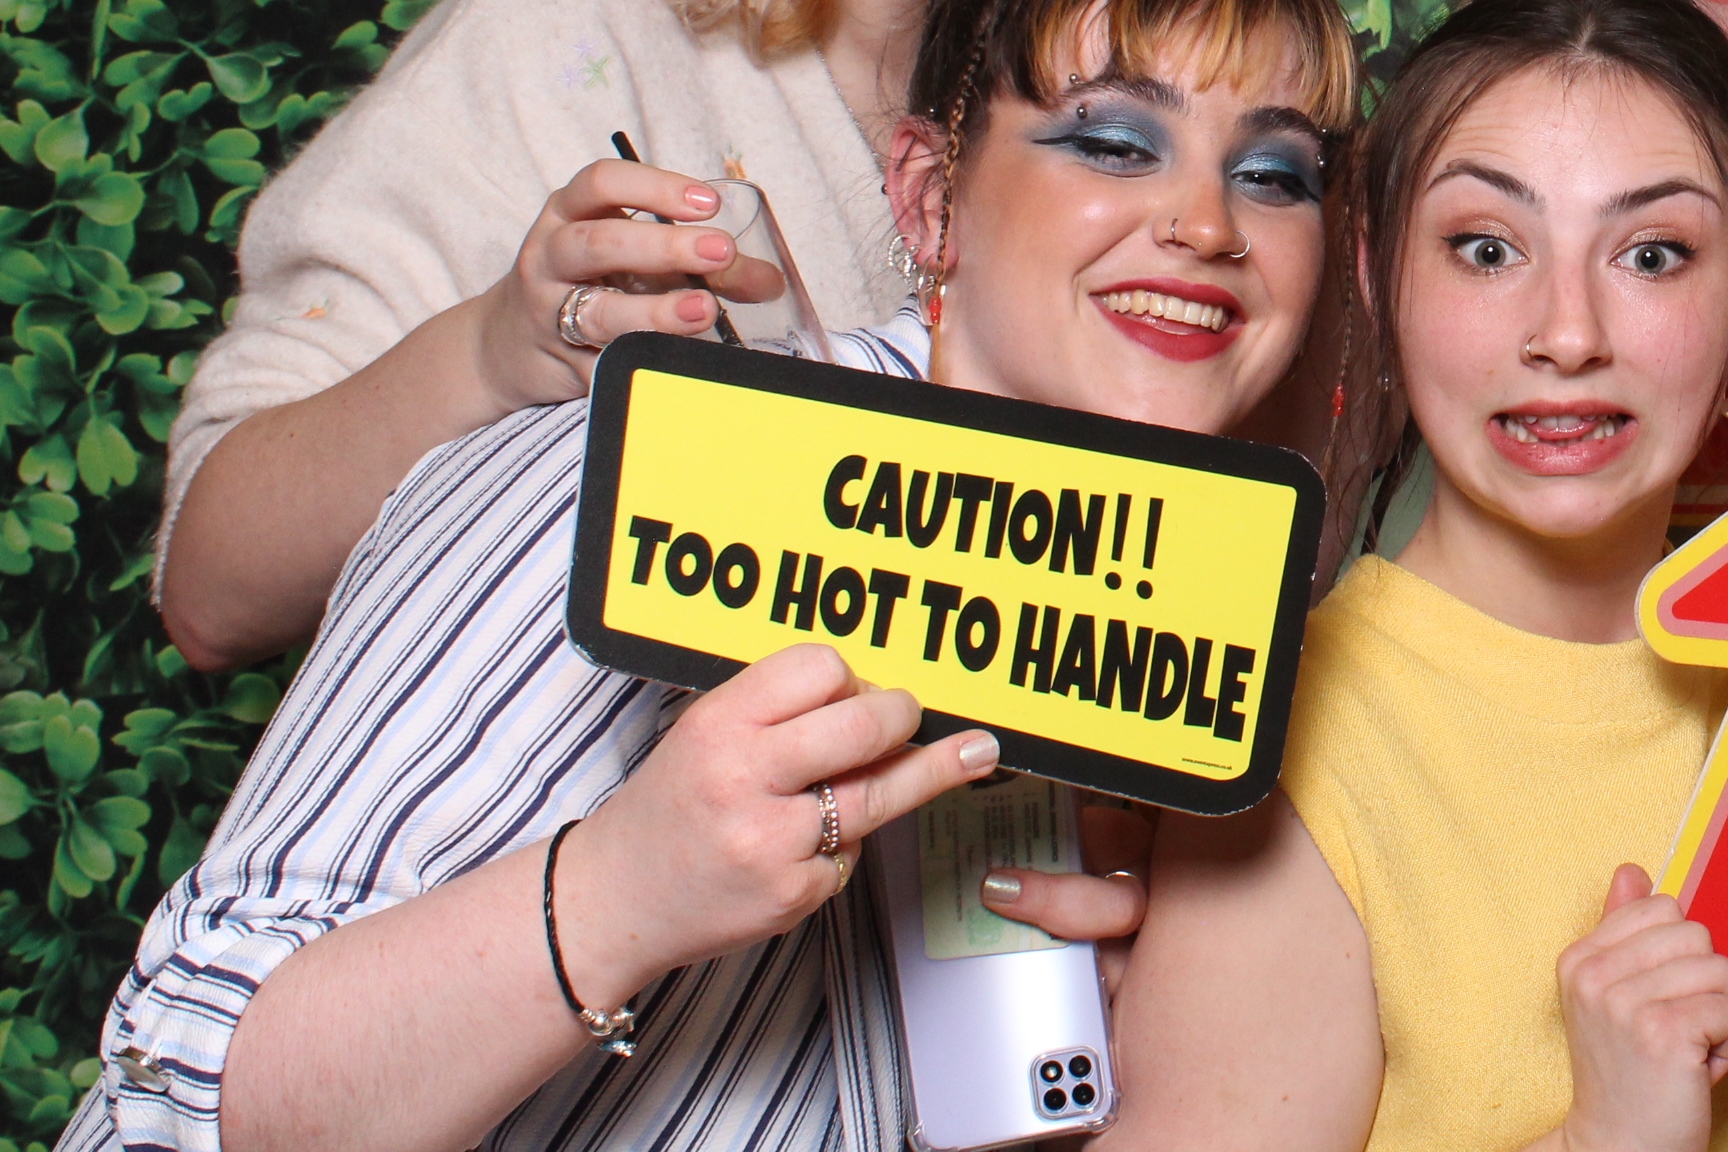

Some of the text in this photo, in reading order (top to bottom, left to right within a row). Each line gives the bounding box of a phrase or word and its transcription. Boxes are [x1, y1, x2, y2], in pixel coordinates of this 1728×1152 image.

[823, 454, 1164, 600] CAUTION!!
[628, 515, 1256, 743] TOO HOT TO HANDLE
